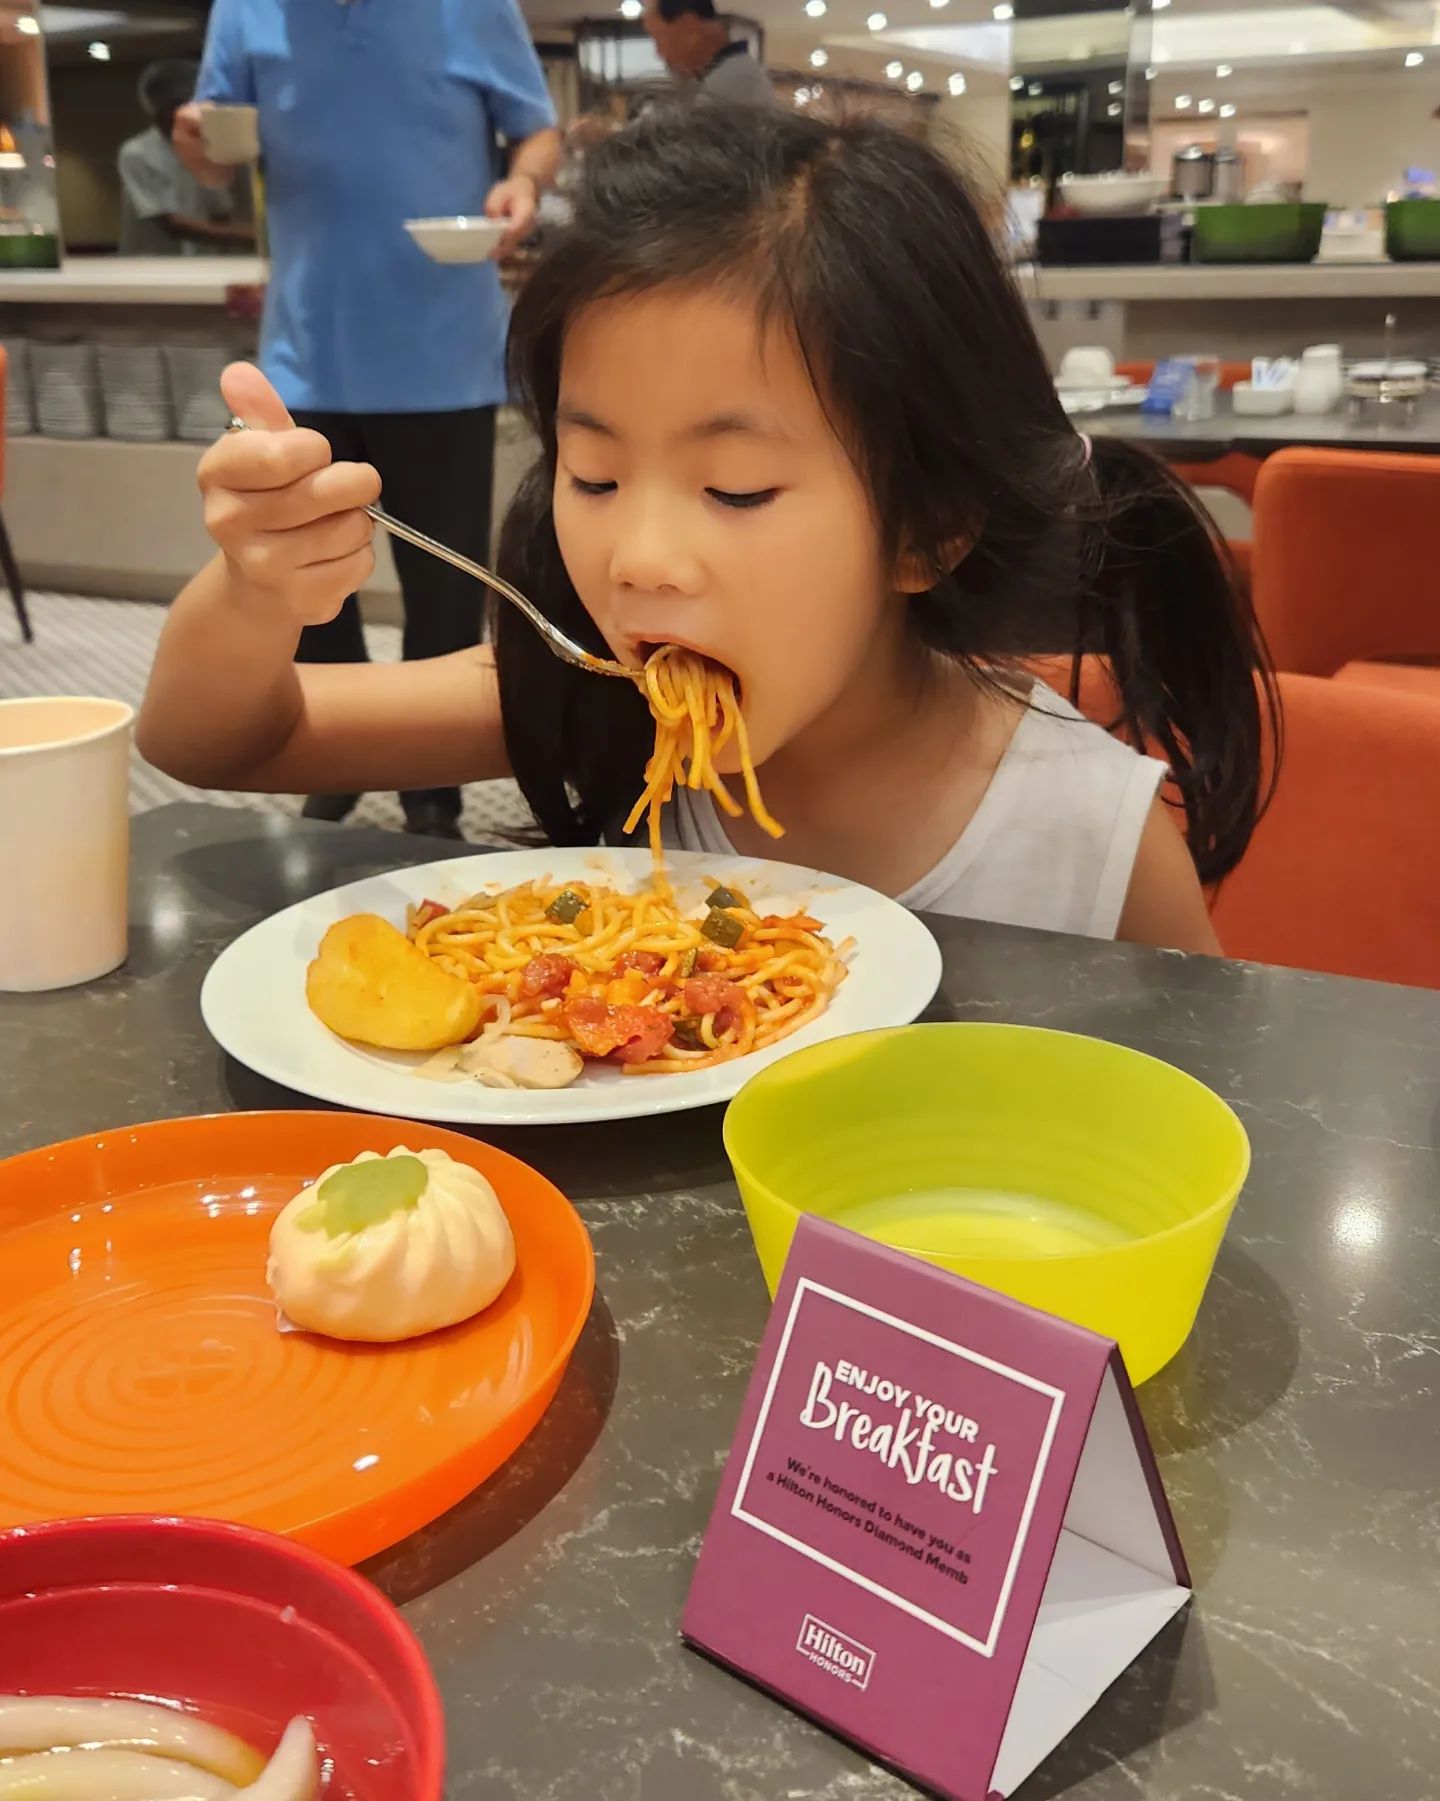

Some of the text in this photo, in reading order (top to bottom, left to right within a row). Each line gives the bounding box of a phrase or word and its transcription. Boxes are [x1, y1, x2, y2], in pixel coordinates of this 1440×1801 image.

[799, 1361, 999, 1514] Breakfast
[834, 1359, 979, 1443] ENJOY YOUR
[766, 1471, 775, 1482] a
[776, 1473, 815, 1502] Hilton
[816, 1493, 862, 1528] Honors
[863, 1519, 924, 1561] Diamond
[787, 1457, 972, 1564] We're honored to have you as
[803, 1623, 867, 1676] Hilton
[808, 1651, 853, 1683] HONORS
